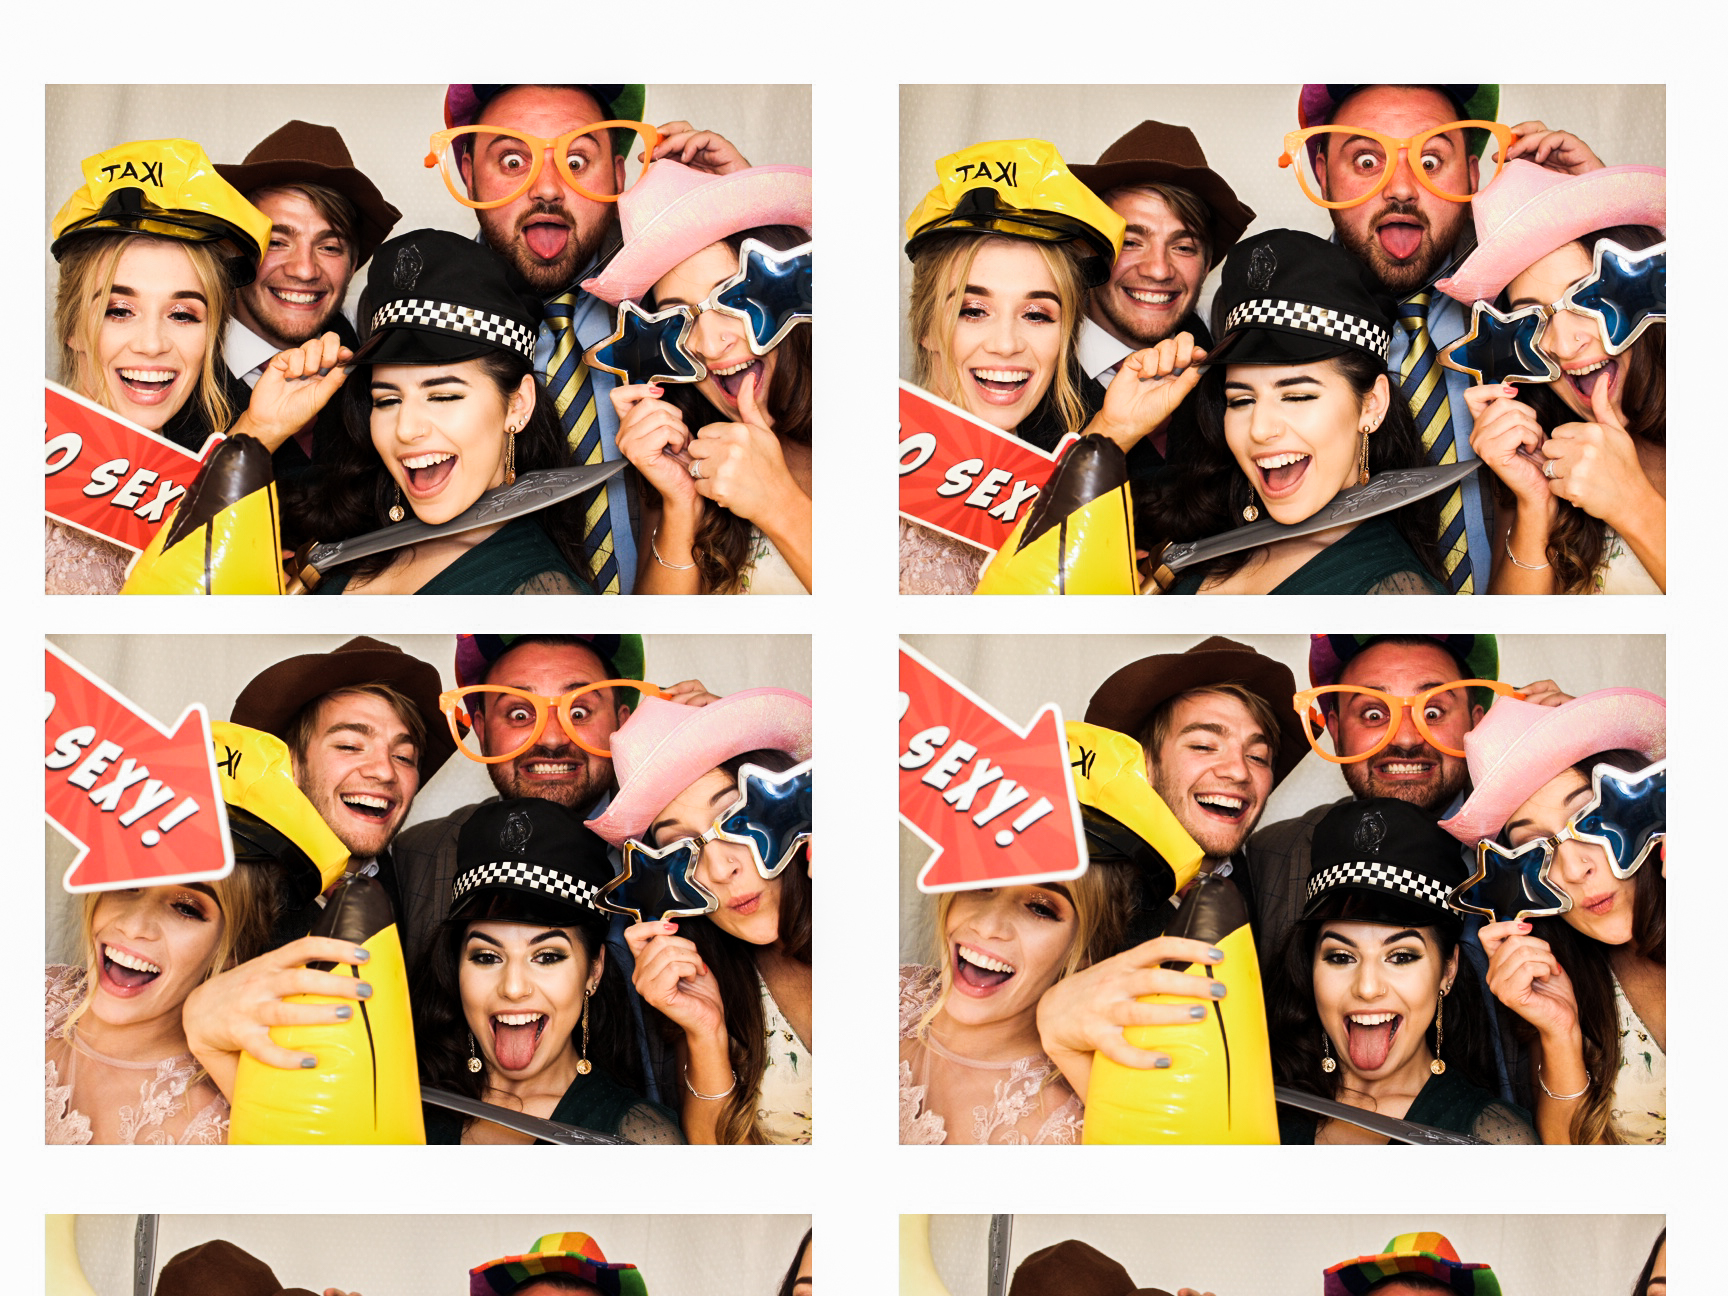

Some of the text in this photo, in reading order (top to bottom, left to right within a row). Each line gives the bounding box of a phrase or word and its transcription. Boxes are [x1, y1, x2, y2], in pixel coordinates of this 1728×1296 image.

[101, 161, 164, 188] TAXI
[955, 161, 1018, 188] TAXI
[45, 421, 187, 524] O SEX
[899, 421, 1041, 524] O SEX
[45, 725, 200, 847] SEXY!
[213, 741, 243, 781] XI
[899, 725, 1054, 847] SEXY!
[1067, 741, 1097, 781] XI
